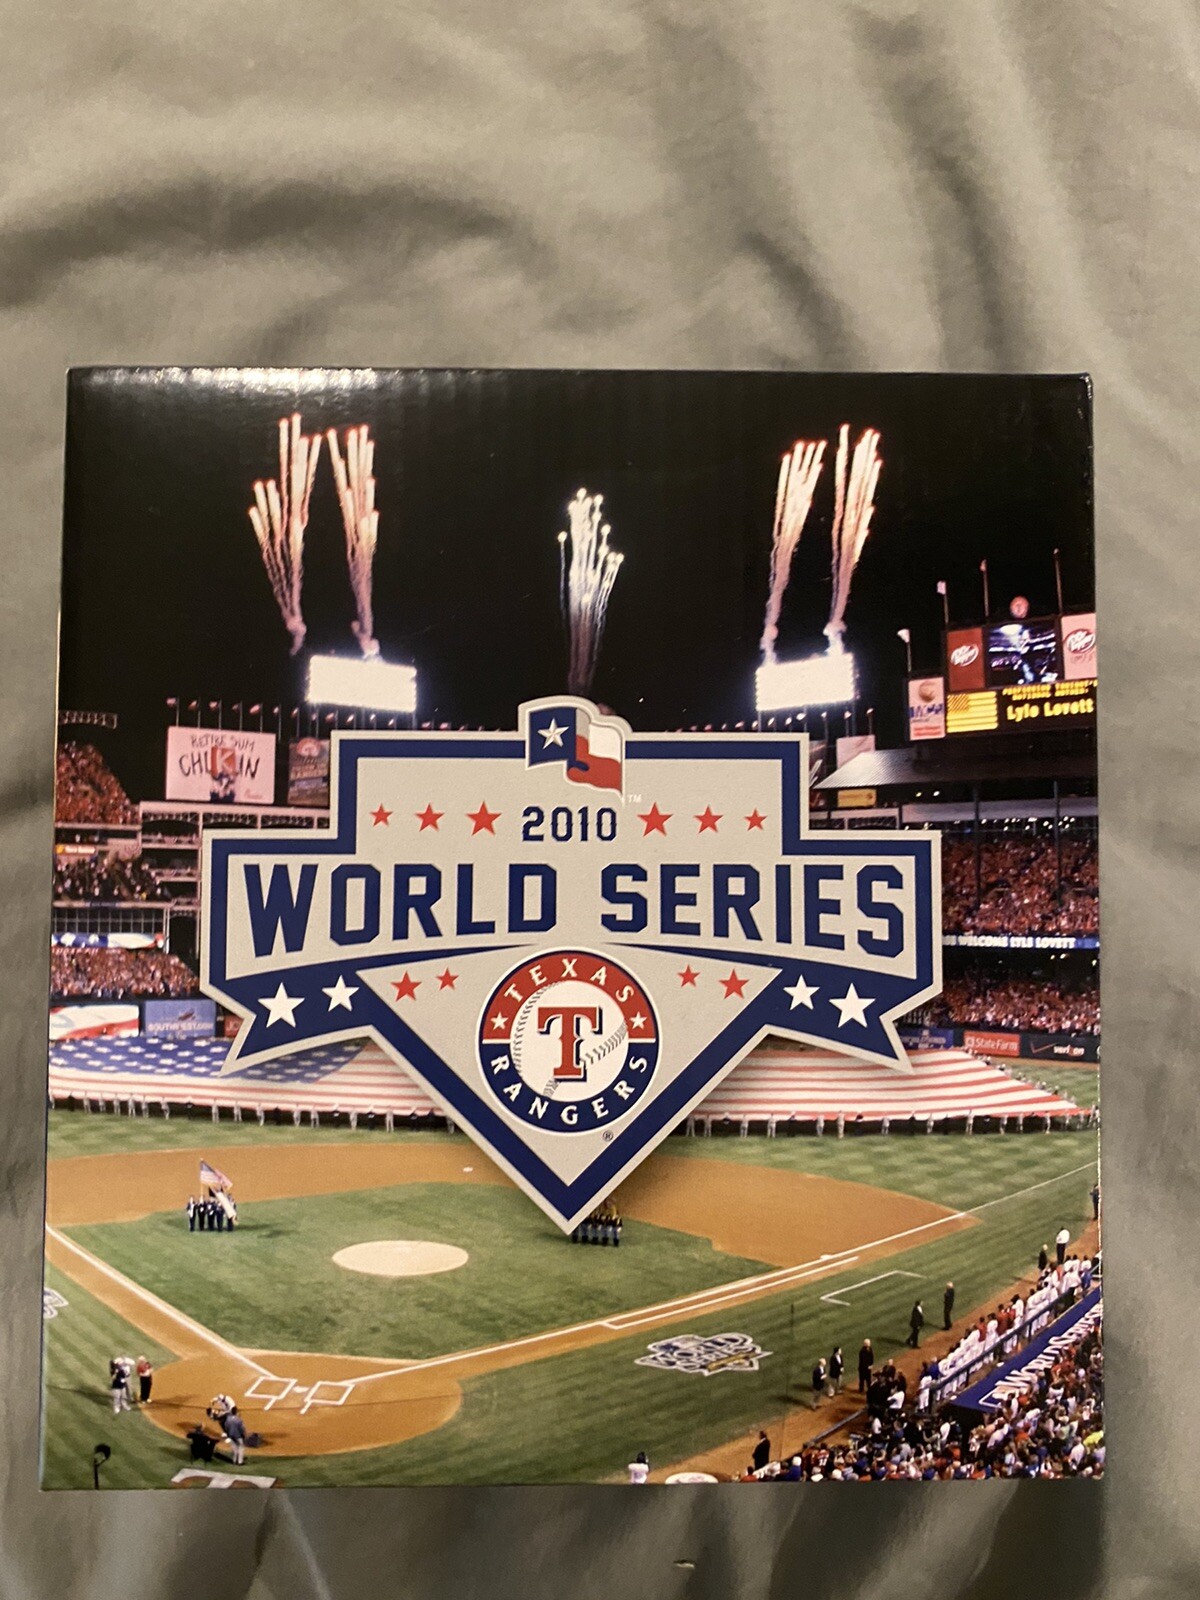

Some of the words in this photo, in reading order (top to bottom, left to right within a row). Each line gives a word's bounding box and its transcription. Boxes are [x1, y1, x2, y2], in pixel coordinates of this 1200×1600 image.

[1006, 703, 1040, 722] Lyle
[1043, 698, 1094, 717] Lovett
[521, 806, 617, 842] 2010
[244, 863, 557, 958] WORLD
[600, 863, 905, 958] SERIES
[504, 958, 635, 1004] TEXAS
[537, 1006, 603, 1082] T
[490, 1054, 648, 1126] RANGERS
